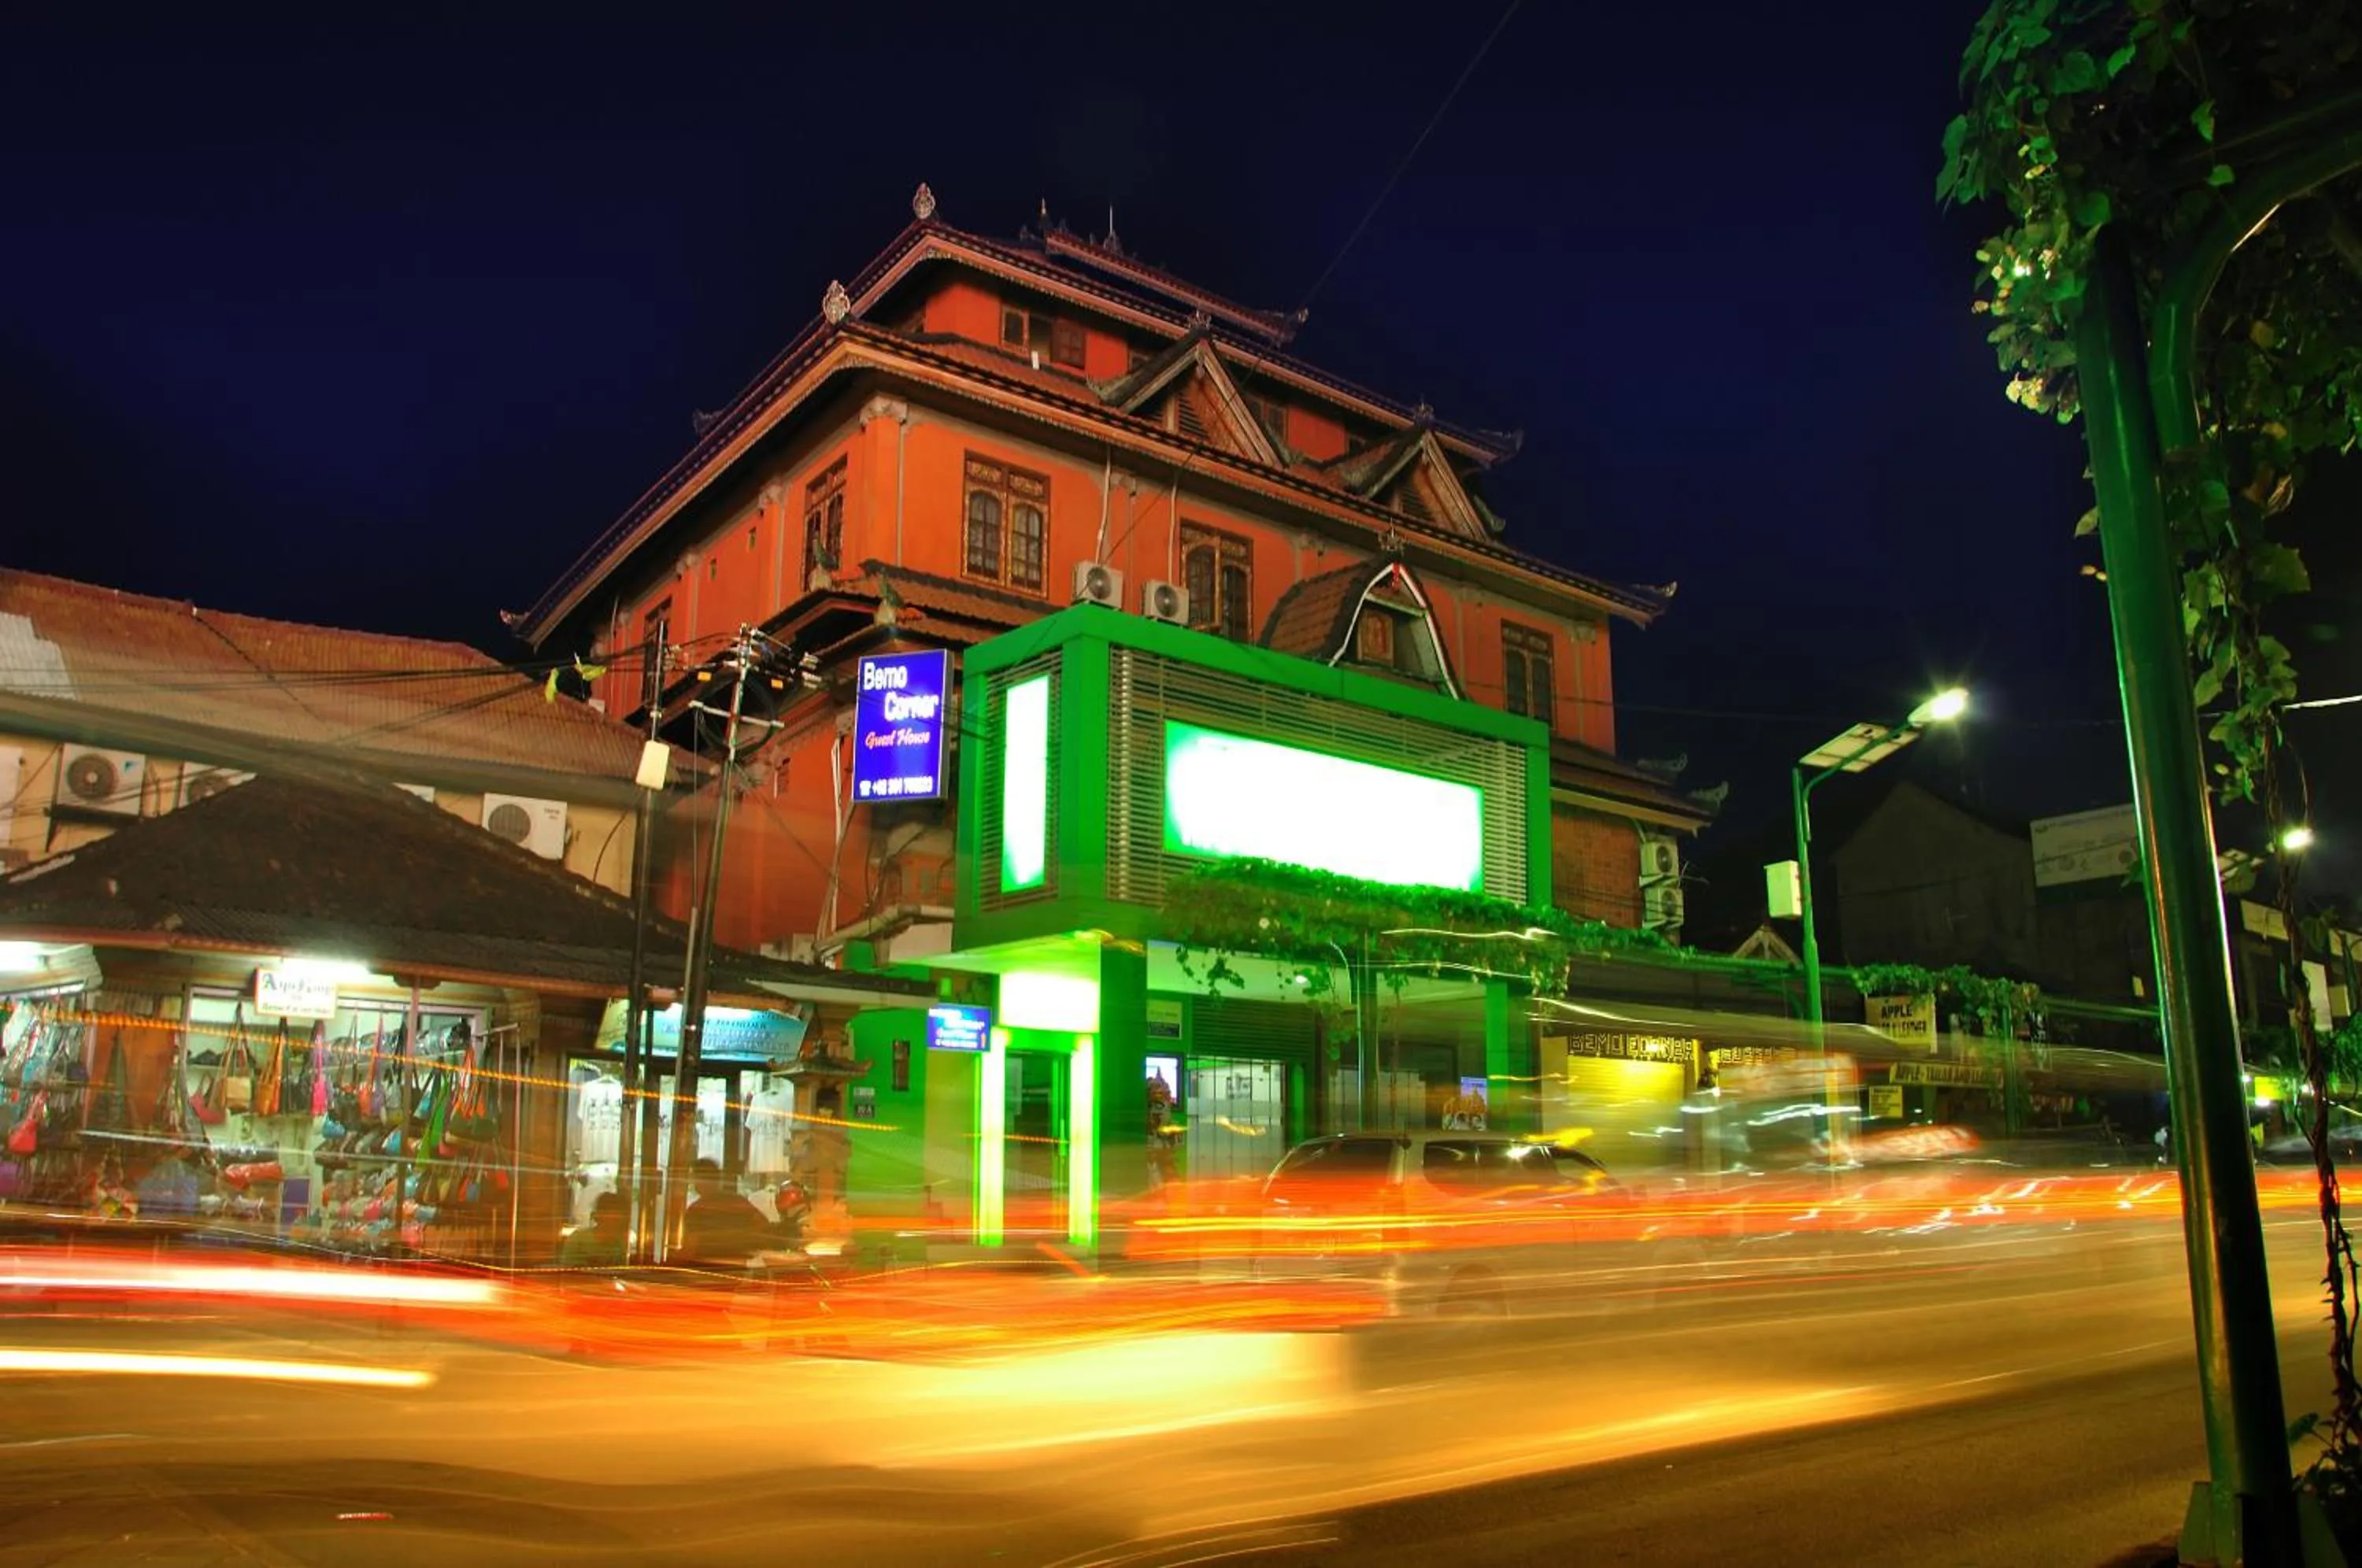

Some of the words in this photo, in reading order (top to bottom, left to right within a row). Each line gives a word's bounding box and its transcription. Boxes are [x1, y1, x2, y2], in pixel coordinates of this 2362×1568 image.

[864, 662, 907, 690] Bemo
[885, 691, 939, 721] Corner
[865, 731, 896, 749] Guest
[897, 727, 931, 746] House
[1881, 1004, 1913, 1019] APPLE
[1570, 1033, 1623, 1056] BEMO
